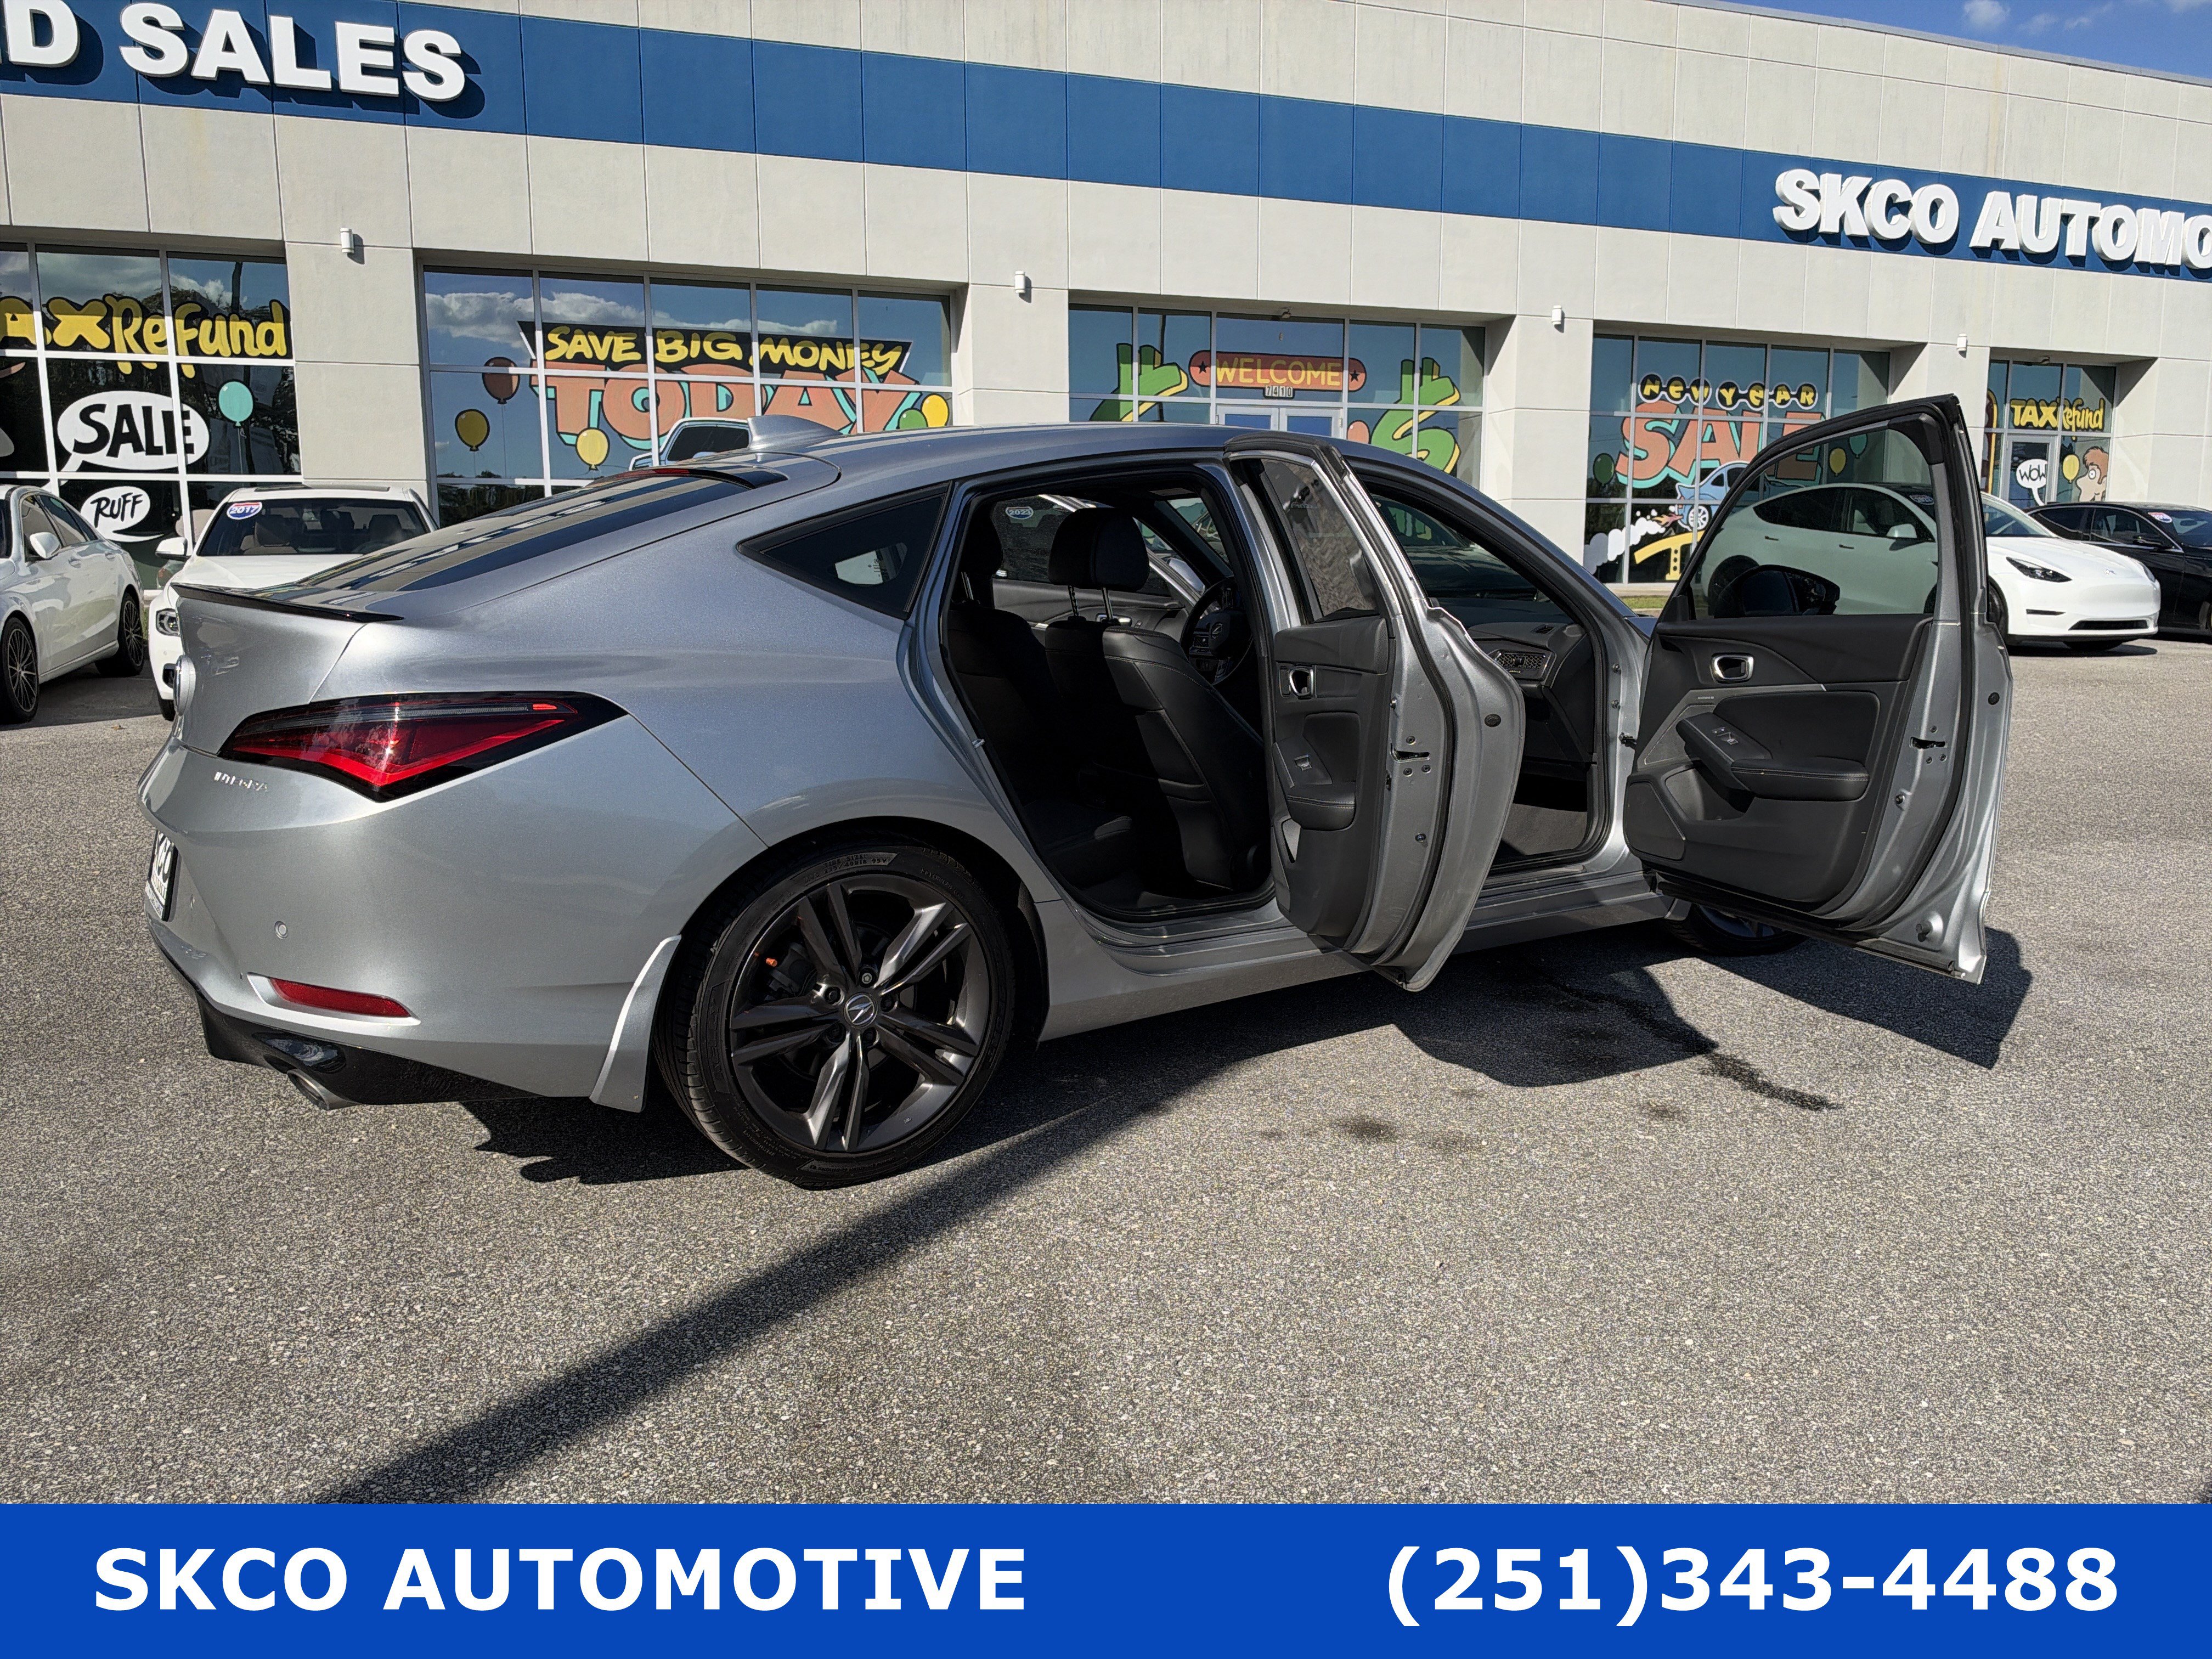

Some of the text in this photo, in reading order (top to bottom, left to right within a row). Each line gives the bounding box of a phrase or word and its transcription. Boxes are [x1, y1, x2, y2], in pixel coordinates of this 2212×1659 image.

[120, 3, 465, 102] SALES
[1773, 168, 2212, 269] SKCO AUTOMO
[104, 295, 287, 379] Refund
[545, 326, 902, 375] SAVE BIG MONEY
[1216, 358, 1342, 386] WELCOME
[1267, 386, 1291, 396] 7410
[530, 359, 921, 449] TODAY
[2011, 400, 2058, 427] TAX
[73, 403, 195, 458] SALE
[1616, 400, 1822, 486] SALE
[91, 493, 143, 528] RUFF
[230, 505, 259, 514] 2017
